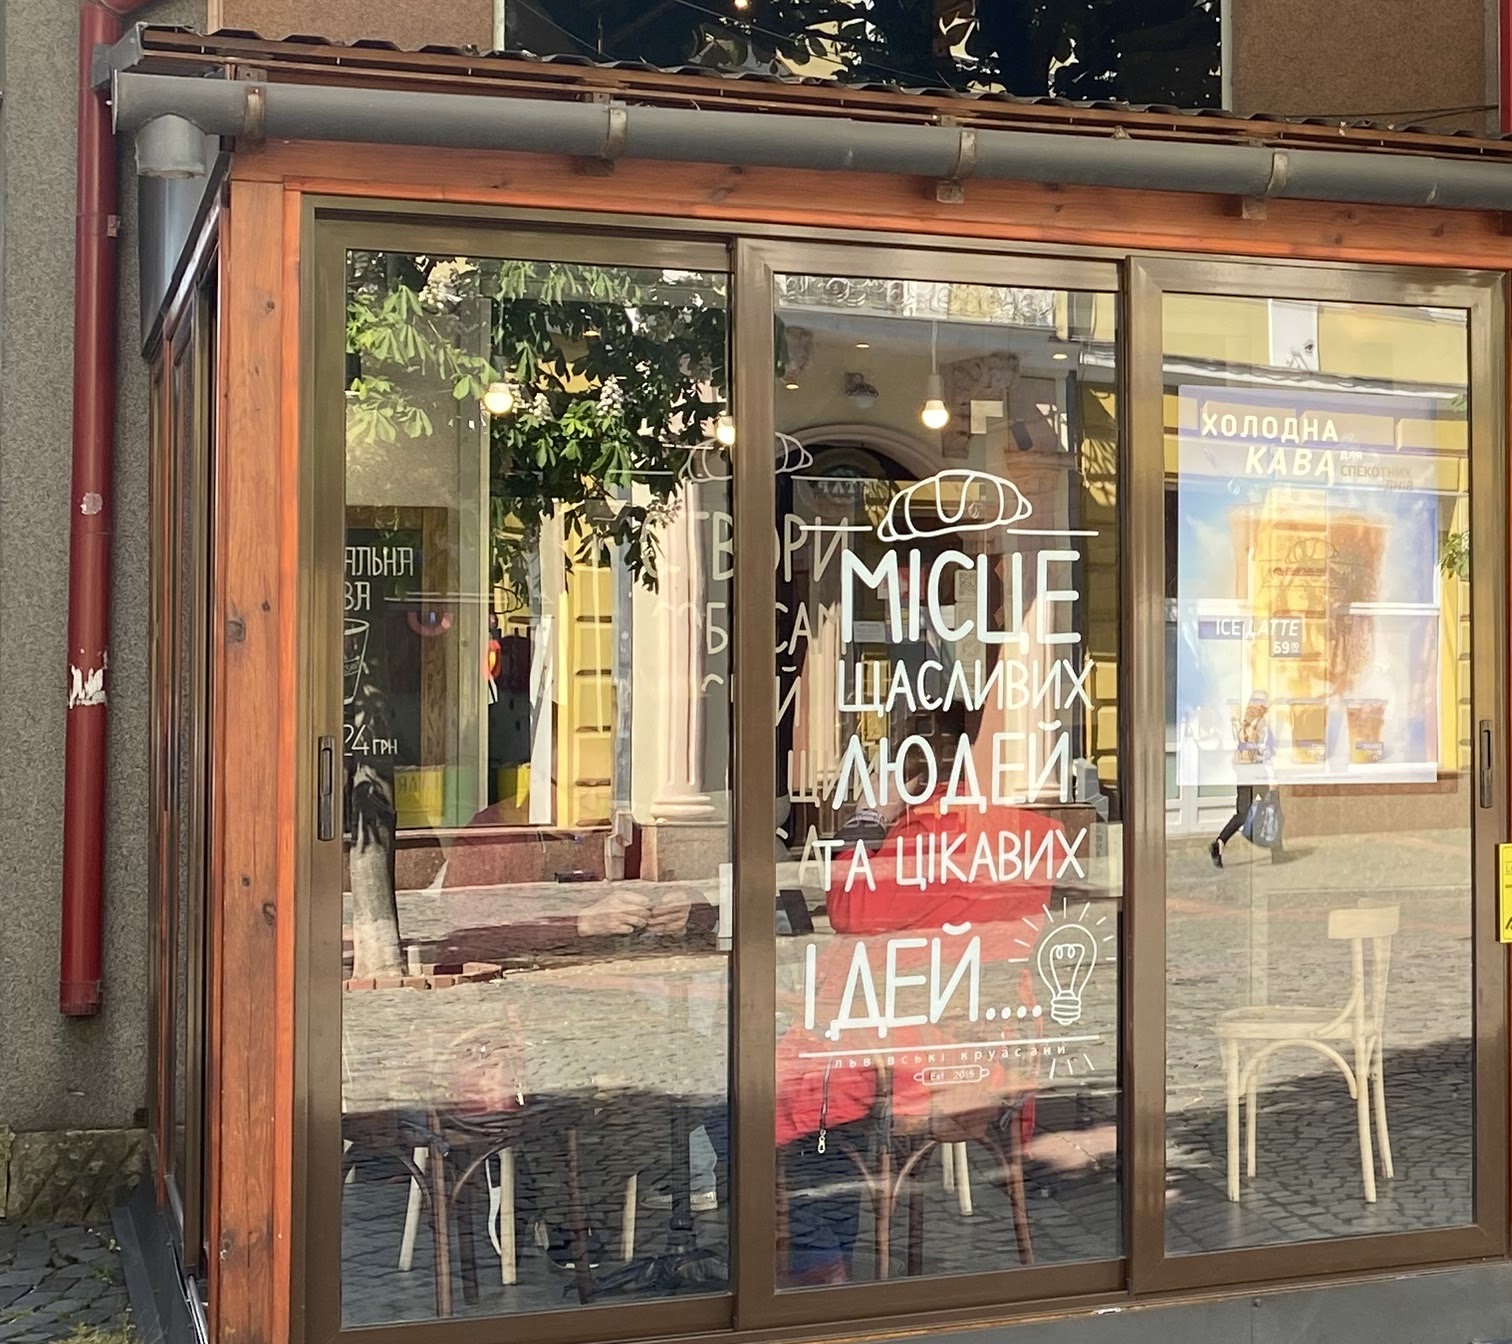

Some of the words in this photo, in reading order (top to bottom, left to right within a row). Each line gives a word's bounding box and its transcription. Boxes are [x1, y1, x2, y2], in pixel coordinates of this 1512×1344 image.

[1201, 412, 1339, 444] ХОЛОДНА
[1245, 445, 1336, 477] КАВА
[841, 548, 1082, 655] МІСЦЕ
[1215, 617, 1241, 637] ICE
[1245, 617, 1300, 638] LATTE
[838, 658, 1097, 718] ЩАСЛИВИХ
[831, 719, 1070, 815] ЛЮДЕЙ
[812, 839, 877, 893] ТА
[896, 826, 1088, 892] ЦІКАВИХ
